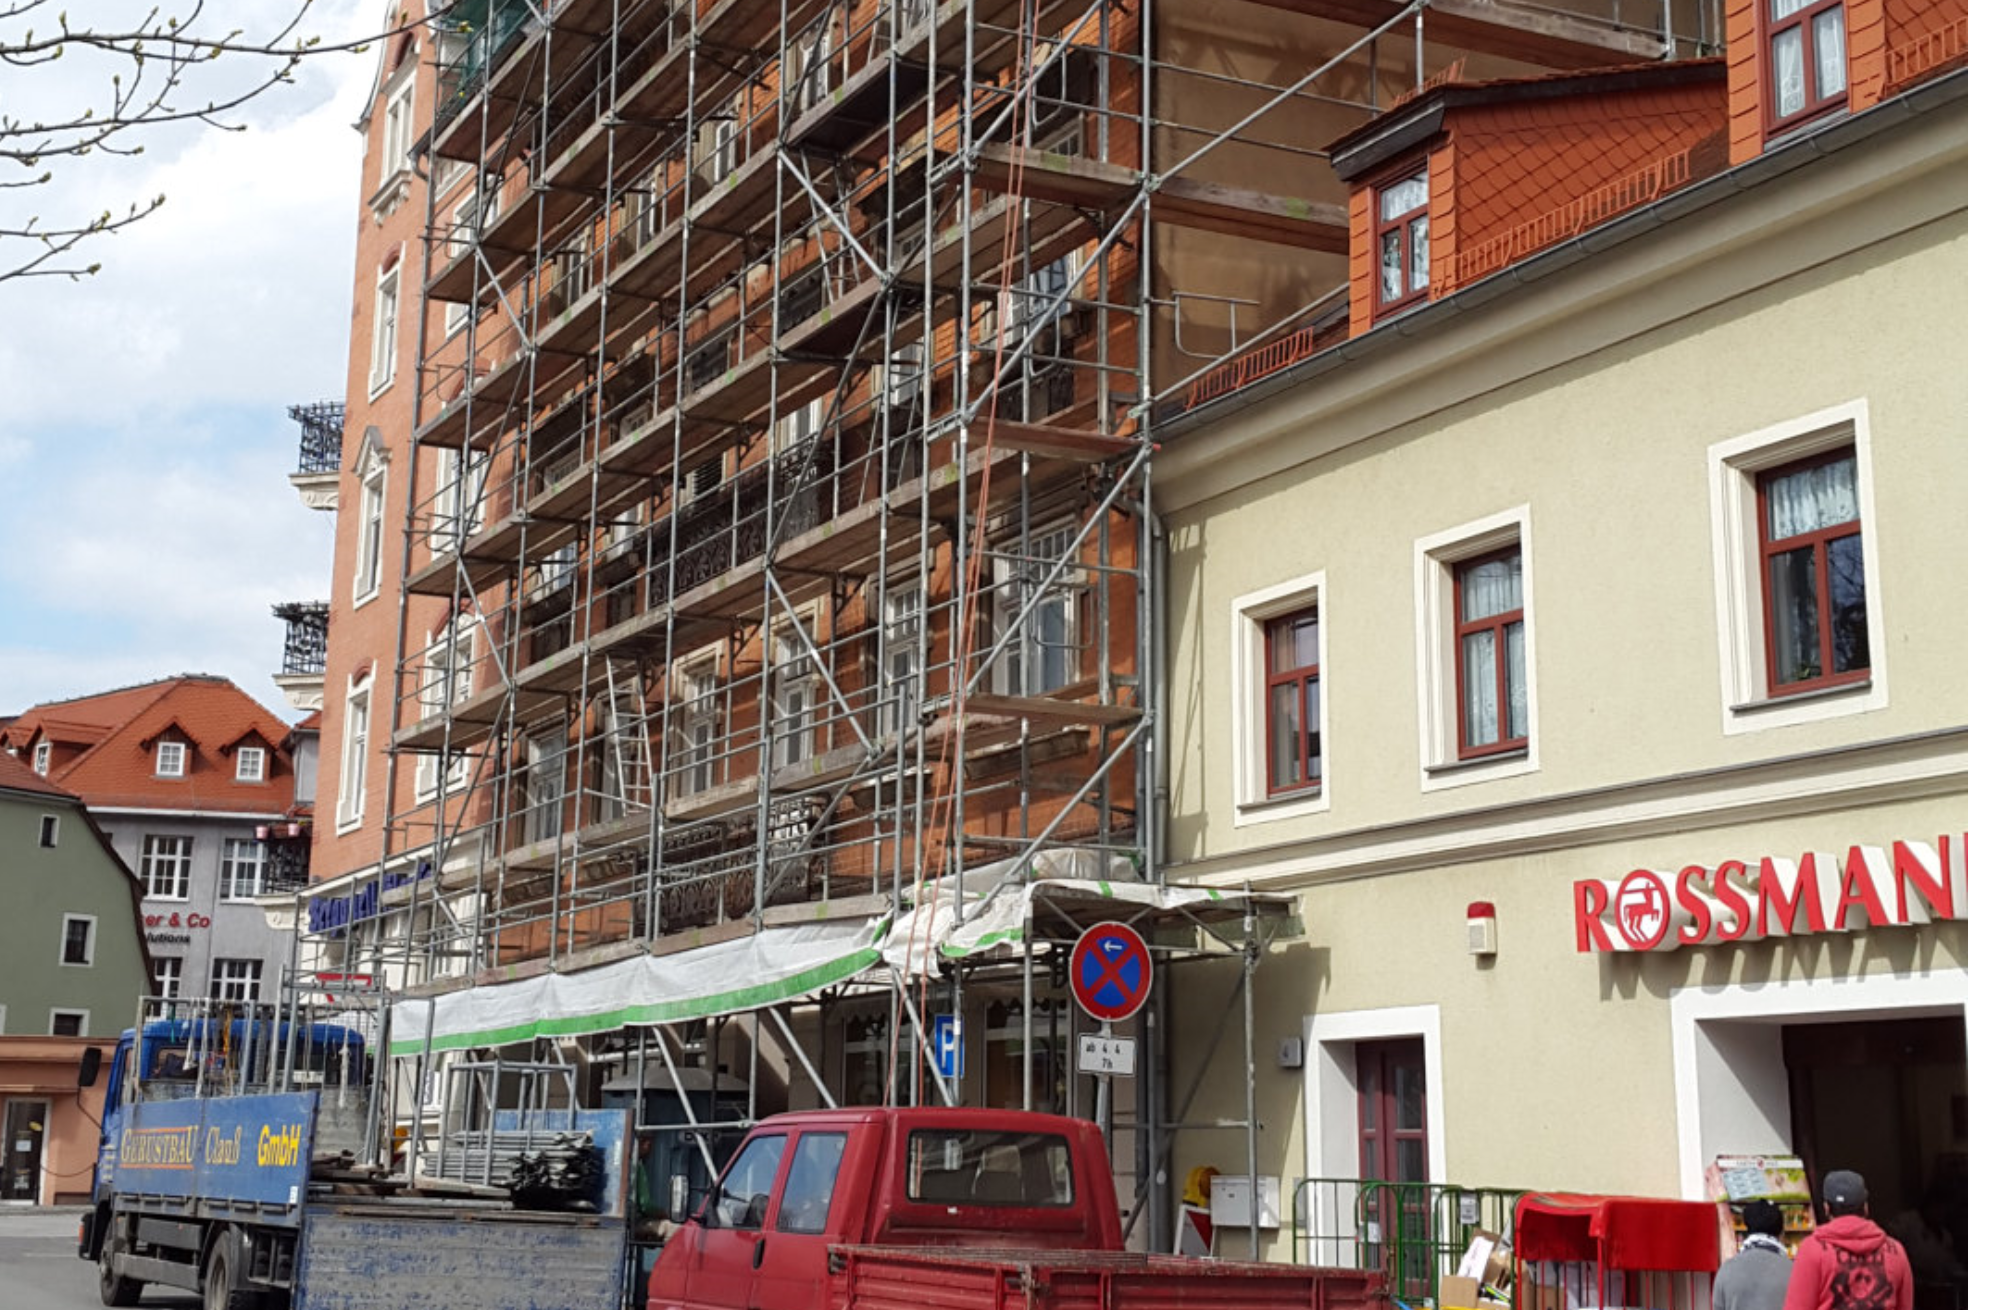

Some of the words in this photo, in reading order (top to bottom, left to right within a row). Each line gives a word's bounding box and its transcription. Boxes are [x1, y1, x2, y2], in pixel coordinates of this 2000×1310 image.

[1573, 832, 1968, 953] ROSSMAN
[145, 914, 164, 927] er
[168, 912, 180, 928] &
[187, 912, 211, 928] Co
[147, 932, 191, 943] lutions
[257, 1124, 302, 1167] GmbH
